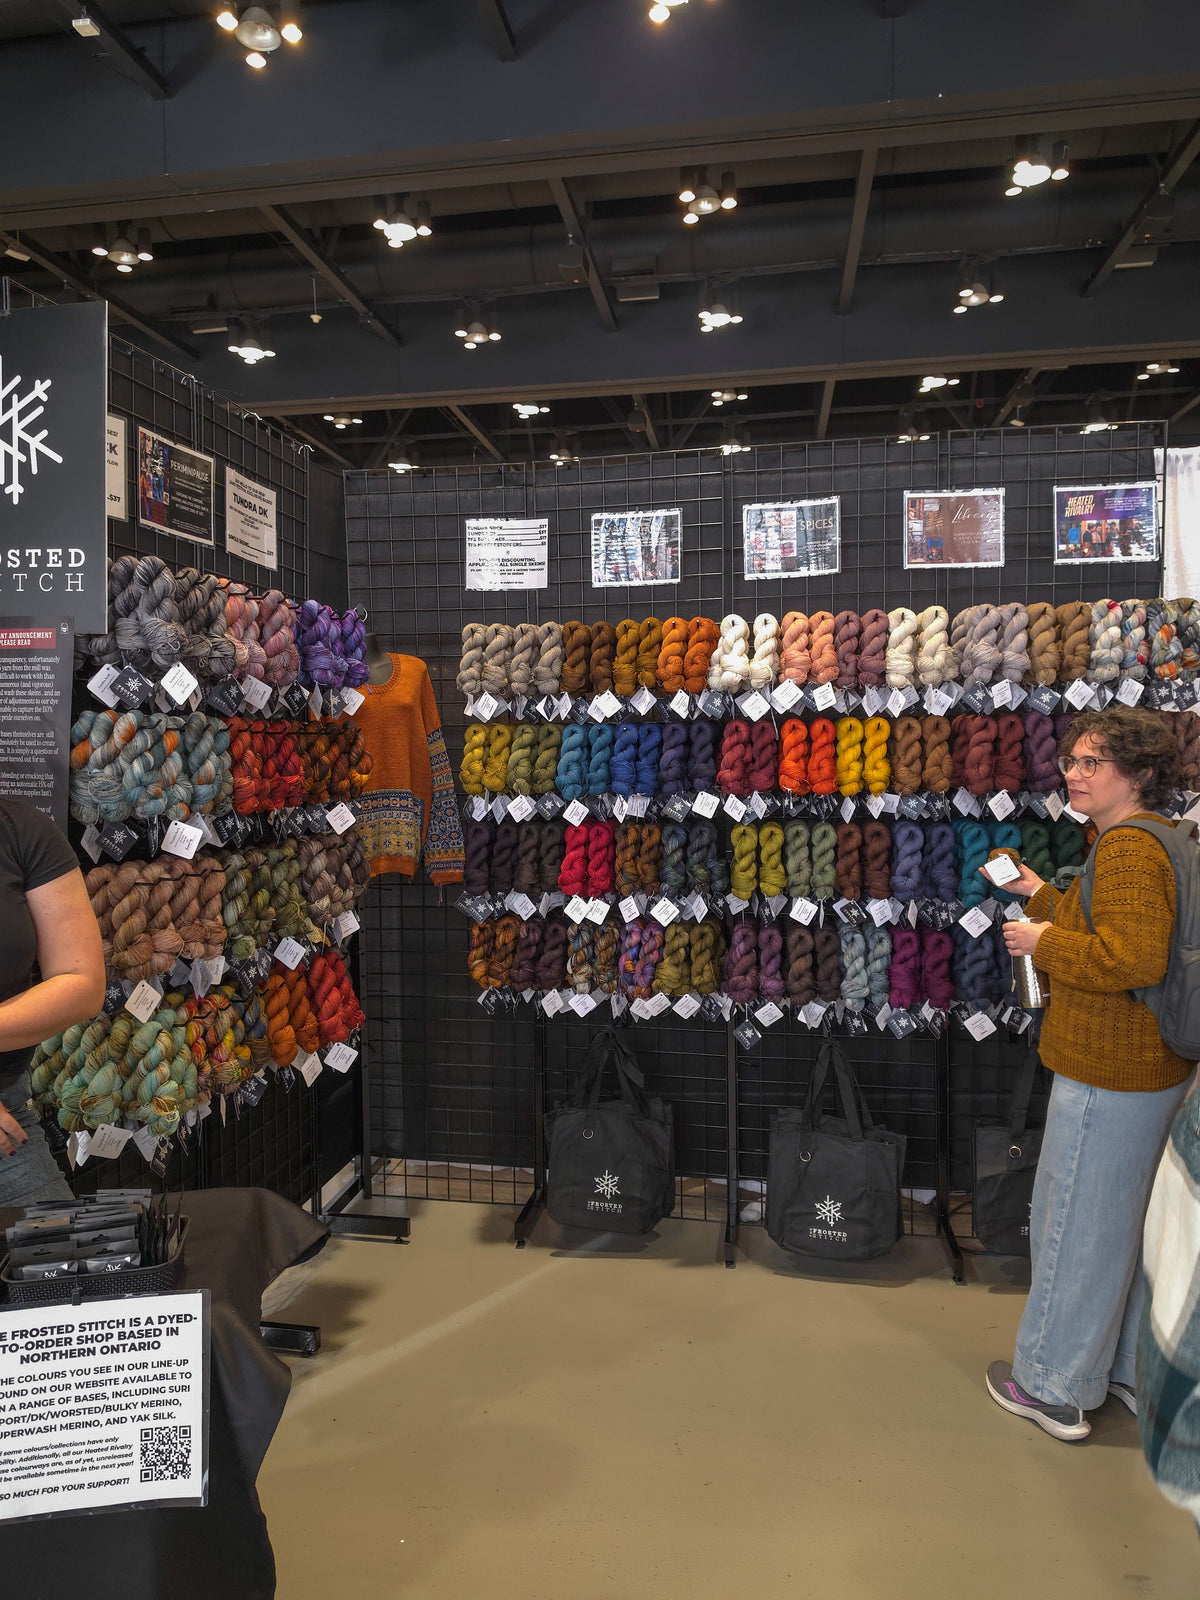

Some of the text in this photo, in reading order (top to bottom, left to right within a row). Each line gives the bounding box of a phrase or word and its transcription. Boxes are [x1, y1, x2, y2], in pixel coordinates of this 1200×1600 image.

[107, 442, 118, 456] K
[233, 492, 257, 513] TUNDRA
[258, 506, 268, 518] DK
[1065, 504, 1095, 517] RIVALRY
[1068, 495, 1094, 507] HEATED
[800, 519, 833, 530] SPICES
[0, 549, 86, 568] STED
[0, 573, 84, 592] TCH
[9, 631, 53, 639] ANNOUNCEMENT
[813, 1228, 848, 1237] FROSTED
[11, 1324, 75, 1340] FROSTED
[78, 1318, 125, 1332] STITCH
[129, 1317, 141, 1327] IS
[144, 1316, 154, 1326] A
[158, 1314, 197, 1325] DYED-
[0, 1326, 179, 1354] TO-ORDER SHOP BASED IN
[20, 1340, 161, 1364] NORTHERN ONTARIO
[17, 1370, 67, 1384] COLOURS
[69, 1368, 91, 1377] YOU
[94, 1365, 112, 1374] SEE
[114, 1364, 125, 1372] IN
[127, 1362, 149, 1371] OUR
[151, 1359, 189, 1369] LINE-UP
[31, 1386, 47, 1395] ON
[49, 1383, 72, 1393] OUR
[75, 1378, 119, 1390] WEBSITE
[122, 1372, 177, 1384] AVAILABLE
[8, 1404, 16, 1412] A
[19, 1398, 55, 1410] RANGE
[58, 1396, 72, 1405] OF
[74, 1393, 109, 1403] BASES,
[112, 1386, 166, 1398] INCLUDING
[168, 1385, 190, 1393] SURI
[141, 1398, 182, 1408] MERINO,
[60, 1420, 103, 1431] MERINO,
[105, 1416, 127, 1426] AND
[130, 1414, 150, 1423] YAK
[152, 1412, 176, 1421] SILK.
[11, 1463, 50, 1472] colourways
[96, 1452, 133, 1462] unreleased
[18, 1452, 61, 1462] Additionally,
[85, 1446, 109, 1454] Heated
[14, 1472, 45, 1480] available
[46, 1467, 79, 1476] sometime
[12, 1489, 40, 1499] MUCH
[41, 1486, 59, 1494] FOR
[62, 1483, 85, 1492] YOUR
[87, 1477, 130, 1489] SUPPORT!
